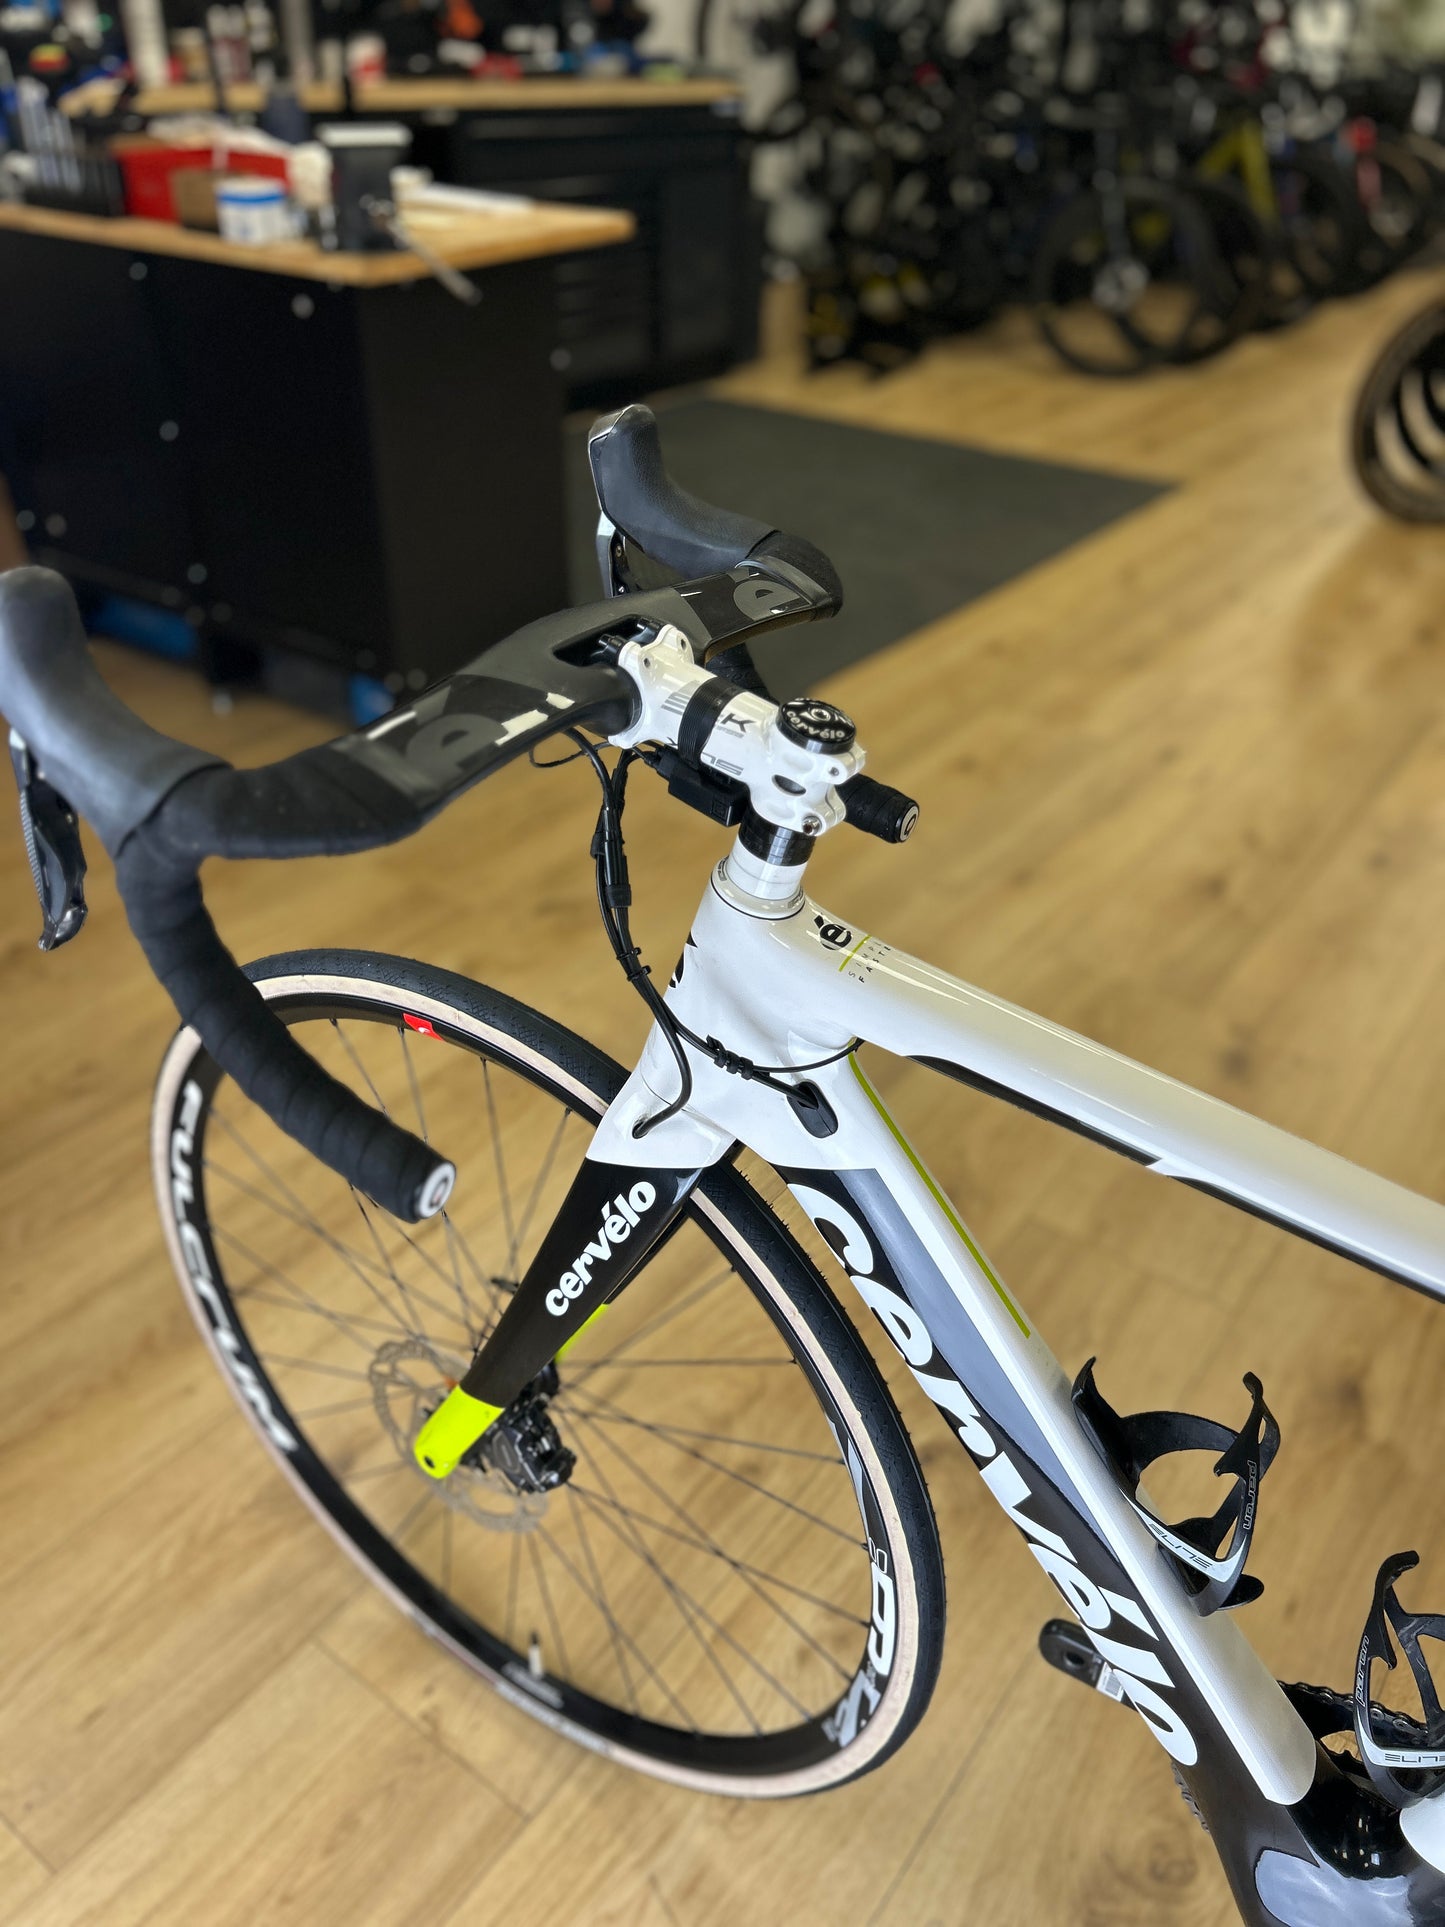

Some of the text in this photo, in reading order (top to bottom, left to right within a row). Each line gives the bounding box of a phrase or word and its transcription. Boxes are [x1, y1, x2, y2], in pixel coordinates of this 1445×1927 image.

[786, 708, 846, 739] cervélo
[858, 946, 892, 983] FASTE
[171, 1079, 299, 1452] FULCRUM
[545, 1181, 656, 1316] cervélo
[786, 1183, 1199, 1766] cervélo
